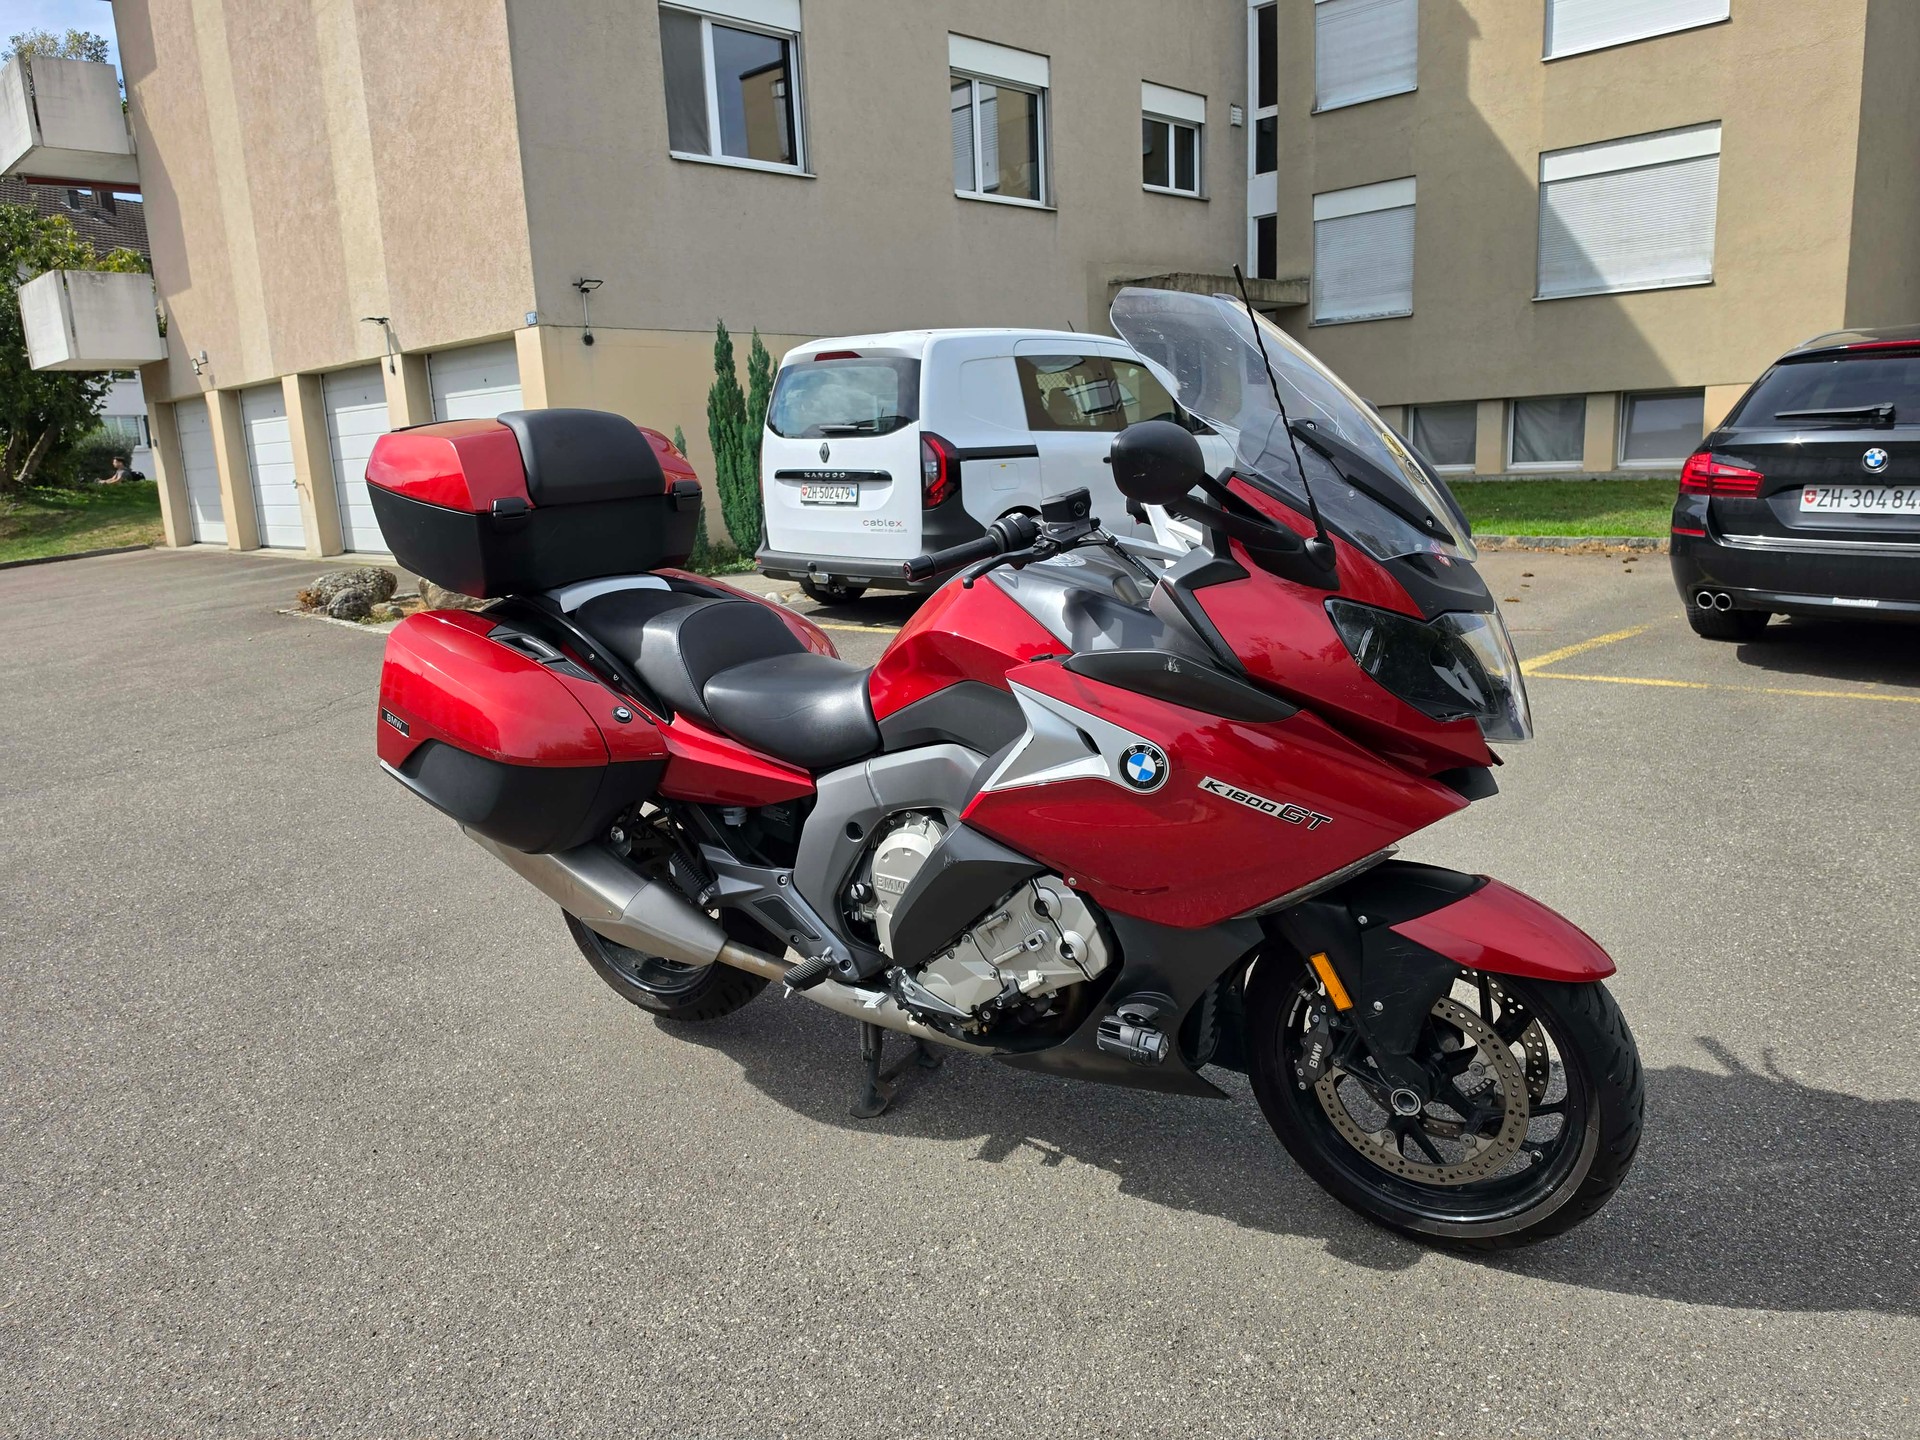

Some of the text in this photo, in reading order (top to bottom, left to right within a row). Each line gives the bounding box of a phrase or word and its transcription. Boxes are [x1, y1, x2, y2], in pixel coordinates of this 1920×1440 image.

[862, 519, 902, 527] cablex
[386, 713, 402, 730] BMW
[1128, 745, 1164, 768] BMW
[876, 875, 907, 895] BMW
[1309, 1042, 1323, 1069] BMW
